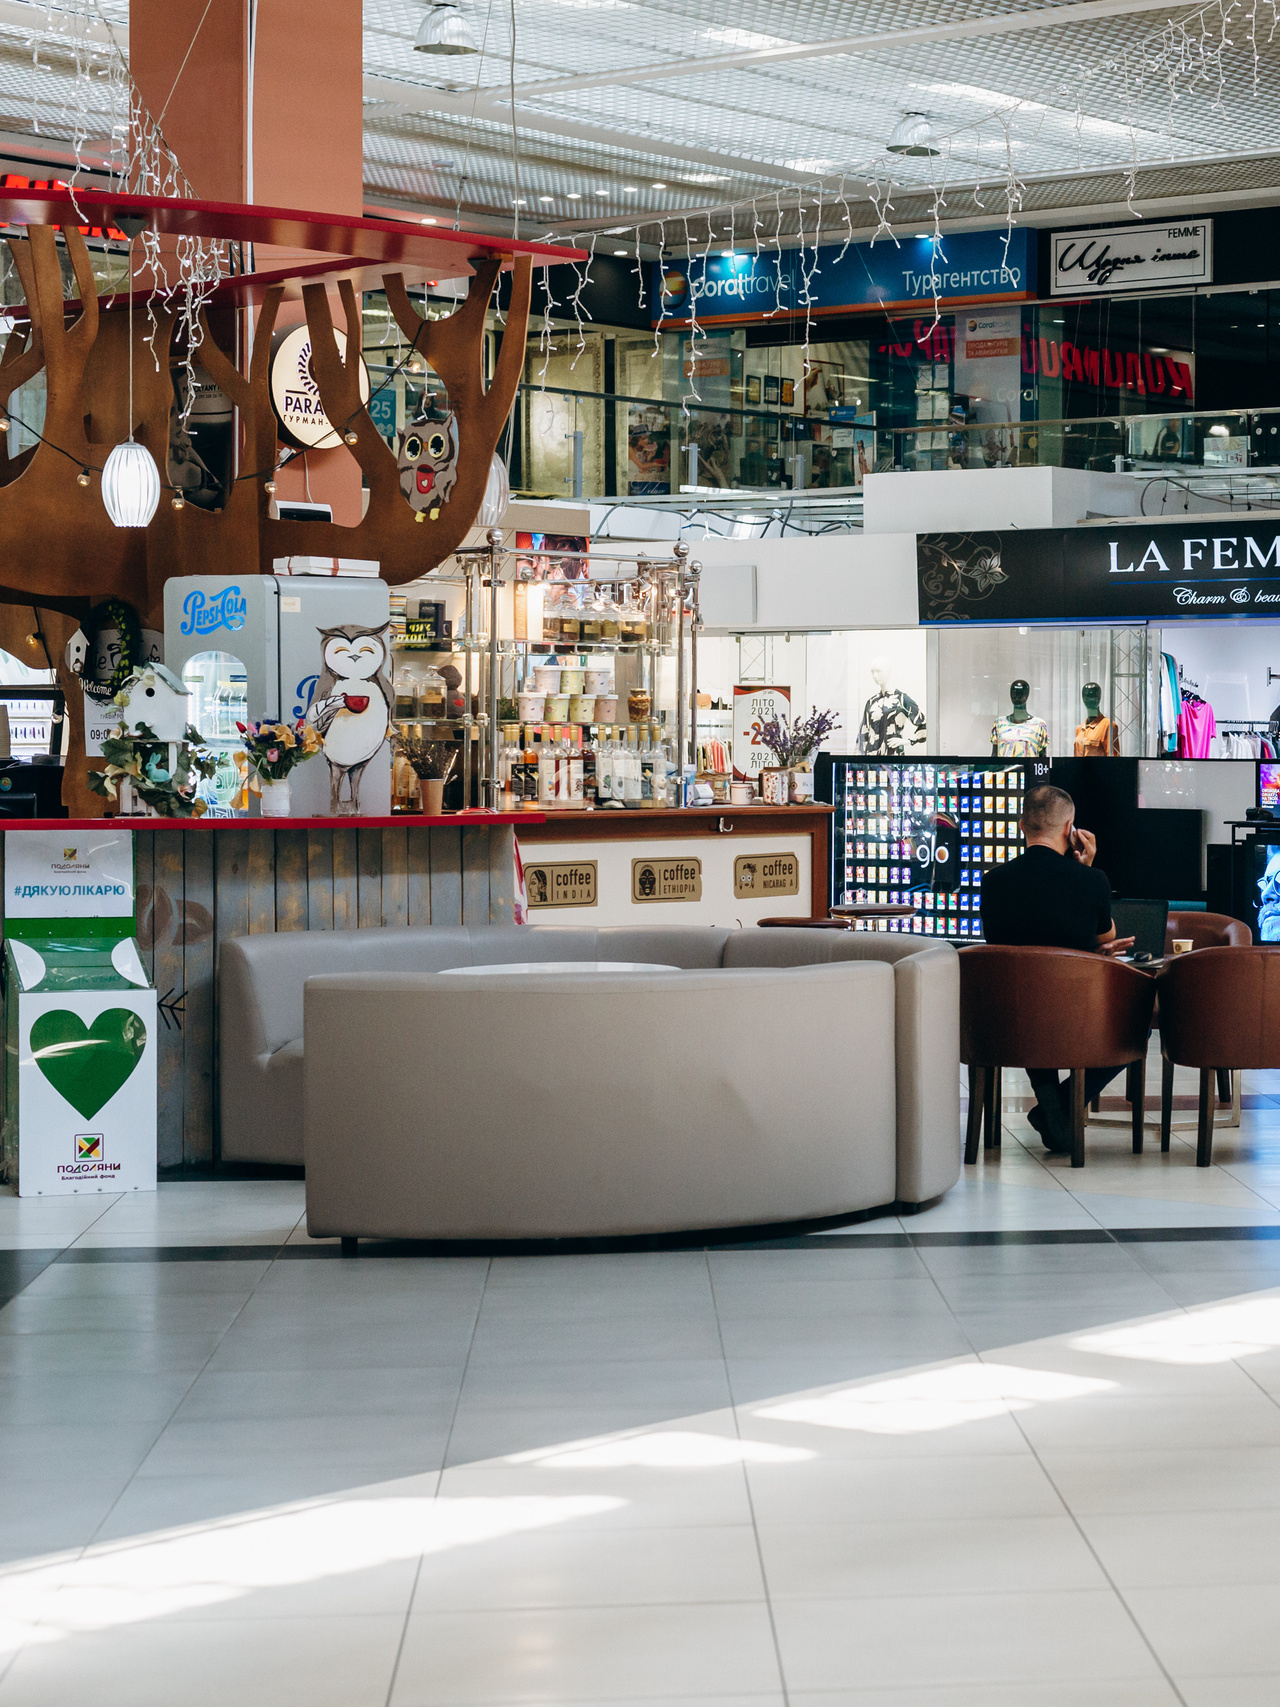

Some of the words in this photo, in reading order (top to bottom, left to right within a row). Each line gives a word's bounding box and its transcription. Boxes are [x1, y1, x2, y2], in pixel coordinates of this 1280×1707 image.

[1167, 226, 1201, 239] FEMME
[901, 267, 1021, 297] Турагентство
[1108, 540, 1170, 573] LA
[1172, 586, 1226, 606] Charm
[79, 677, 112, 696] Welcome
[750, 699, 775, 707] ЛІТО
[751, 707, 775, 716] 2021
[750, 752, 775, 760] 2021
[1033, 763, 1049, 776] 18+
[916, 834, 949, 868] glo
[663, 864, 696, 881] coffee
[762, 860, 793, 877] coffee
[555, 869, 592, 886] coffee
[556, 889, 592, 900] INDIA
[663, 884, 696, 894] ETHIOPIA
[57, 1163, 121, 1174] ПОДОЛЯНИ
